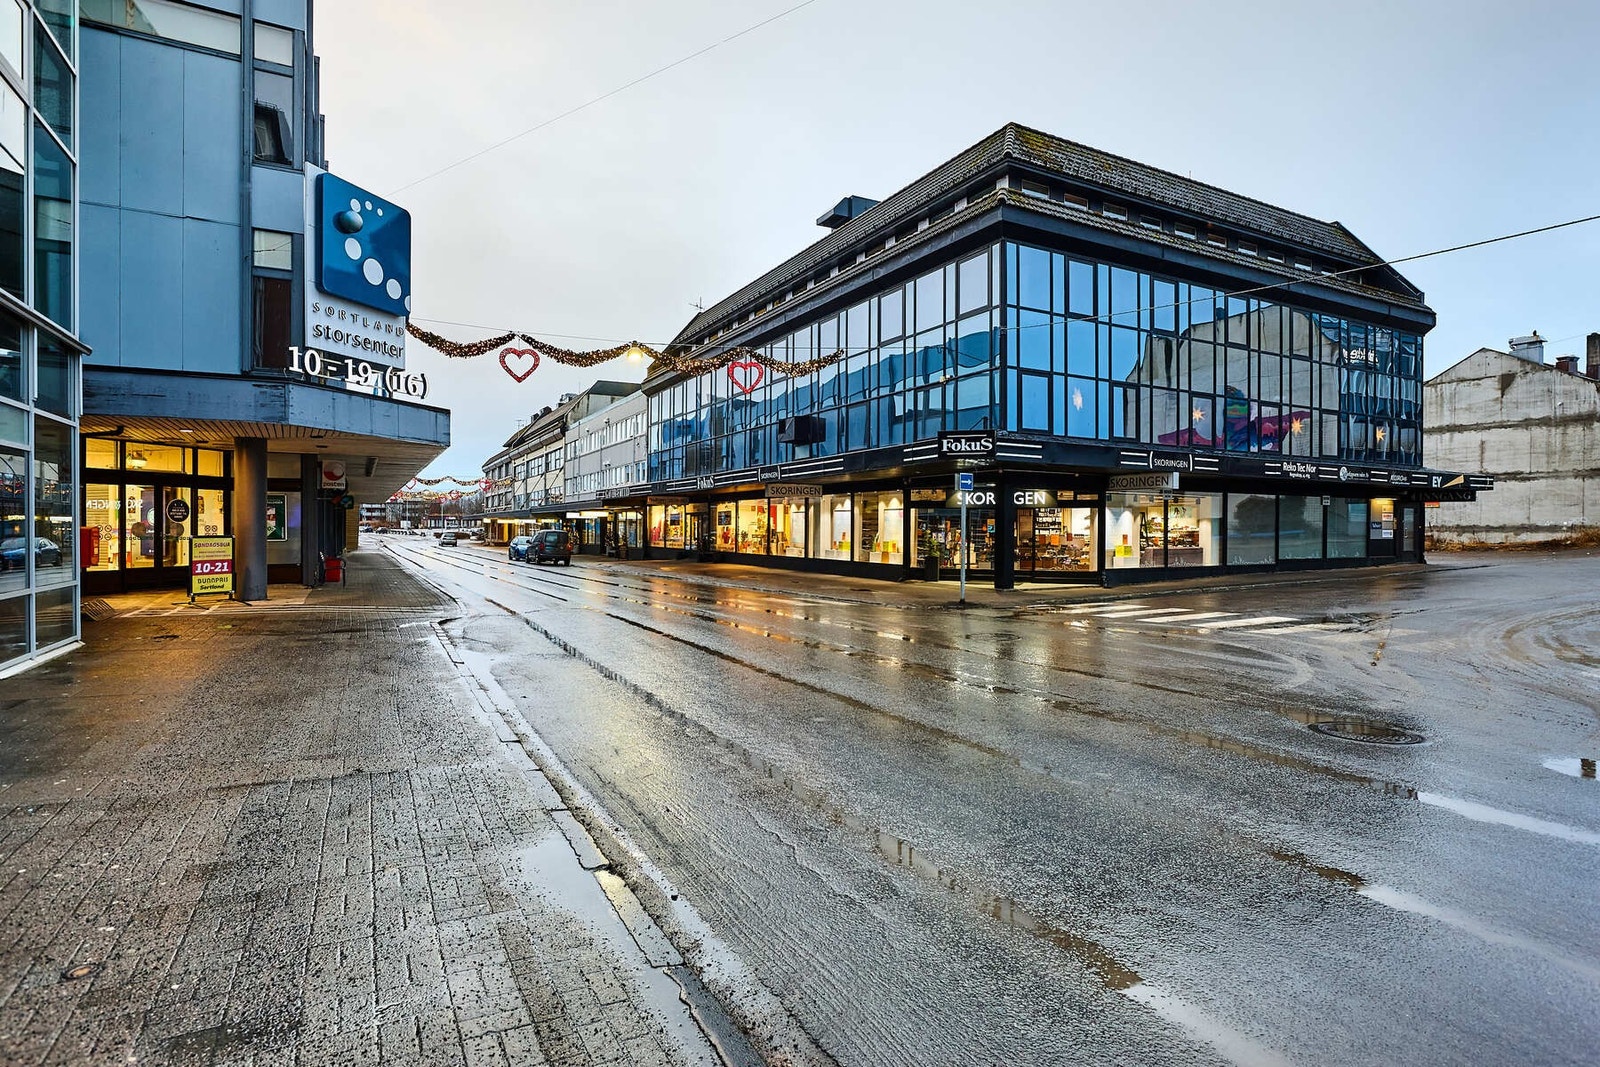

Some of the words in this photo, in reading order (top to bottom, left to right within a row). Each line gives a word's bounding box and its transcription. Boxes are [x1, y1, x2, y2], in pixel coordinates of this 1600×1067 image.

[312, 323, 404, 358] storsenter
[288, 346, 321, 376] 10
[344, 358, 372, 385] 19
[385, 365, 429, 399] (16)
[1110, 475, 1169, 488] SKORINGEN
[1432, 476, 1442, 488] EY
[771, 486, 820, 495] SKORINGEN
[195, 562, 229, 573] 10-21
